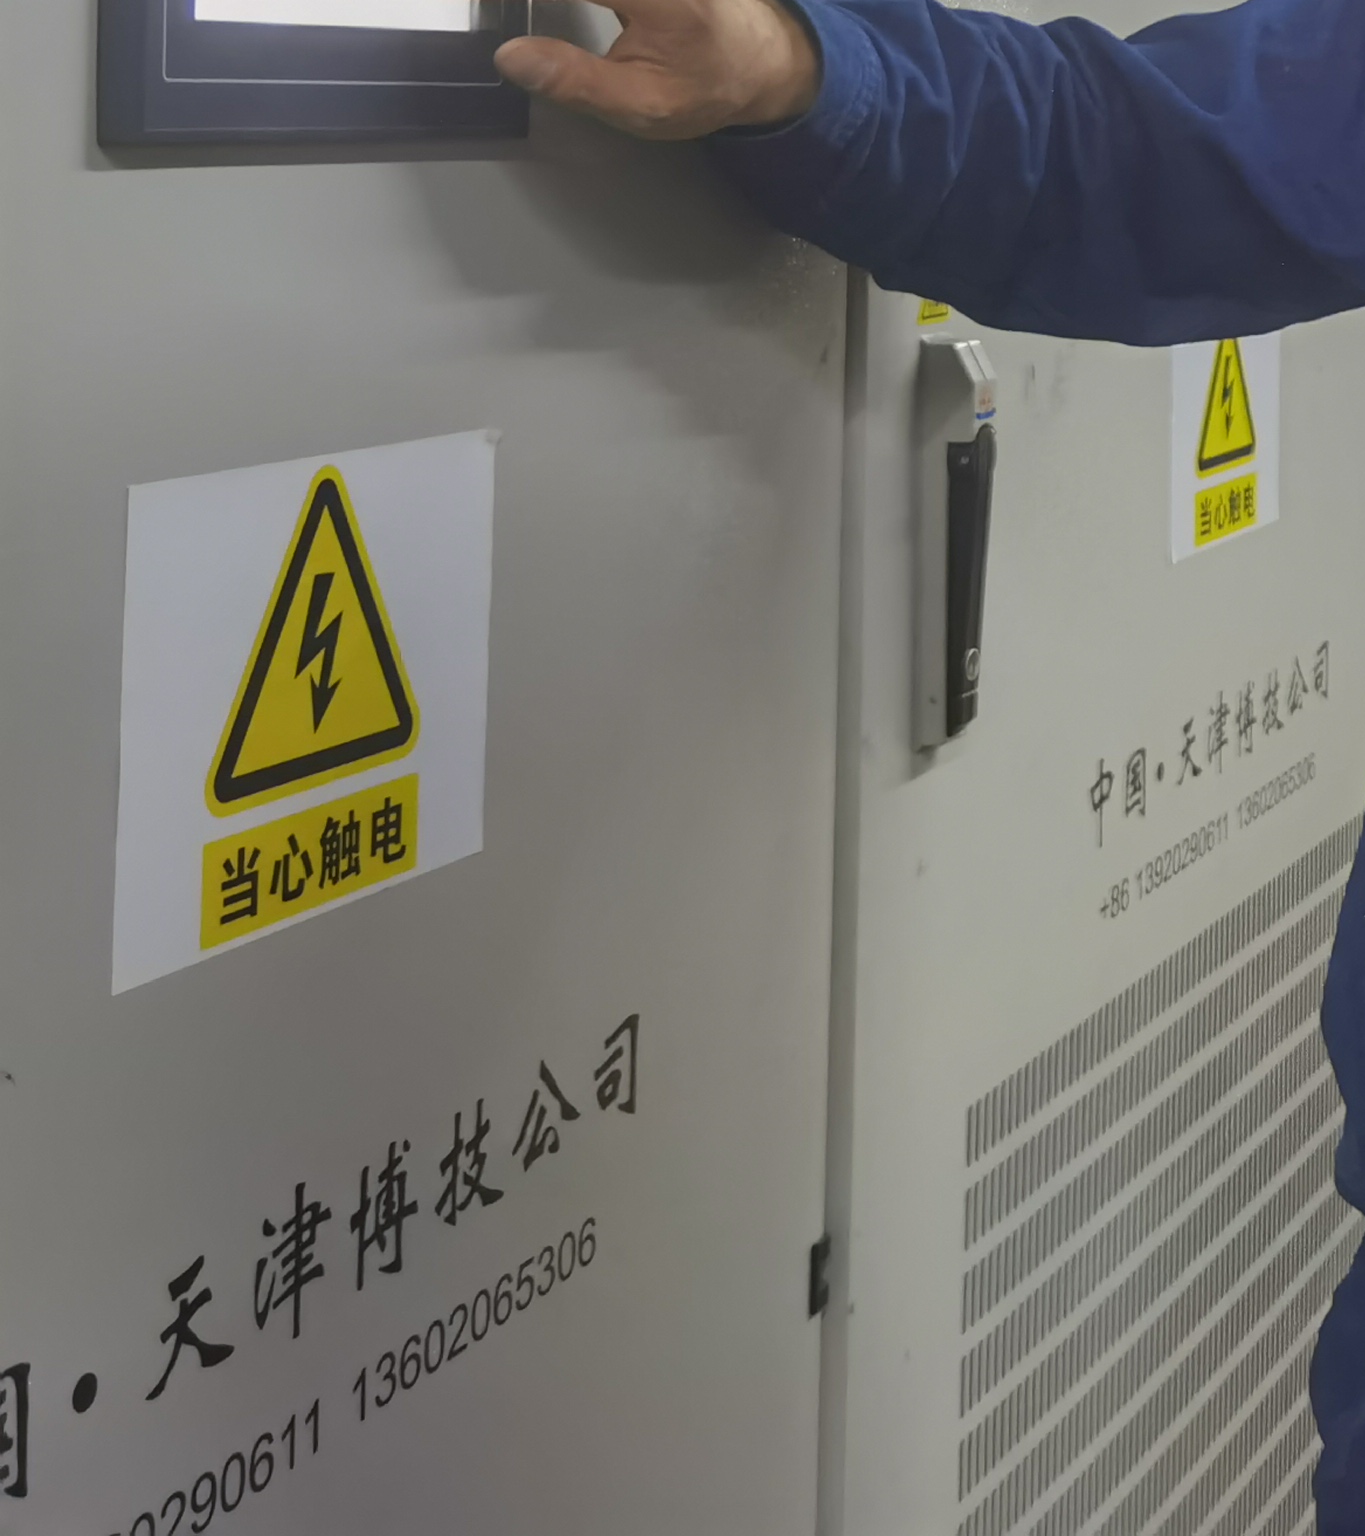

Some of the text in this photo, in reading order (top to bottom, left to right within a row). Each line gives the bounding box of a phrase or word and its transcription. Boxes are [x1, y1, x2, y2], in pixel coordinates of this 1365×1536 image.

[1201, 482, 1255, 537] 当心触电
[219, 797, 407, 927] 当心触电
[1099, 877, 1131, 919] +86
[1136, 812, 1229, 900] 13920290611
[352, 1217, 597, 1421] 13602065306
